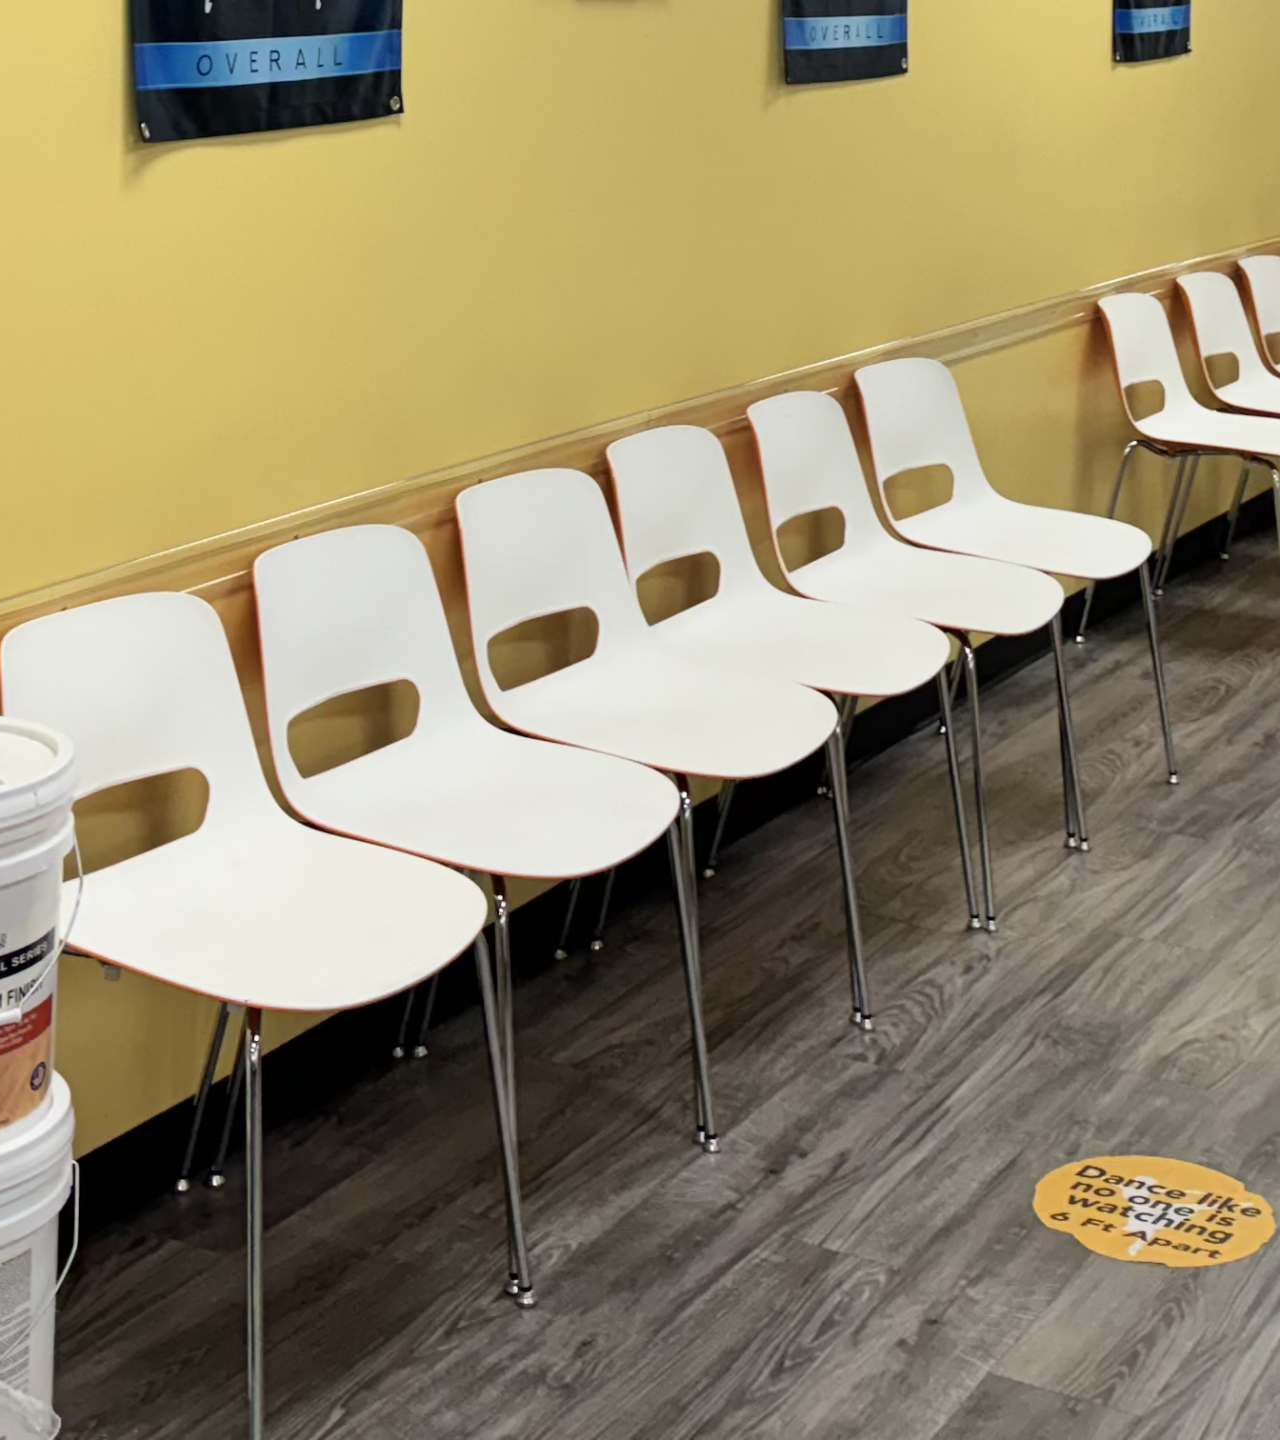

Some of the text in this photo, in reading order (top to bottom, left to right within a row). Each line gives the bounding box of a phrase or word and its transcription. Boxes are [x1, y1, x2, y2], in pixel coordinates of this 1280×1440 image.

[809, 23, 884, 42] OVERALL
[194, 48, 344, 78] OVERALL
[11, 940, 48, 967] SERIES
[1070, 1180, 1237, 1227] no one is
[1074, 1164, 1263, 1218] Dance like
[1050, 1211, 1224, 1260] 6 Ft Apart
[1067, 1194, 1235, 1245] watching
